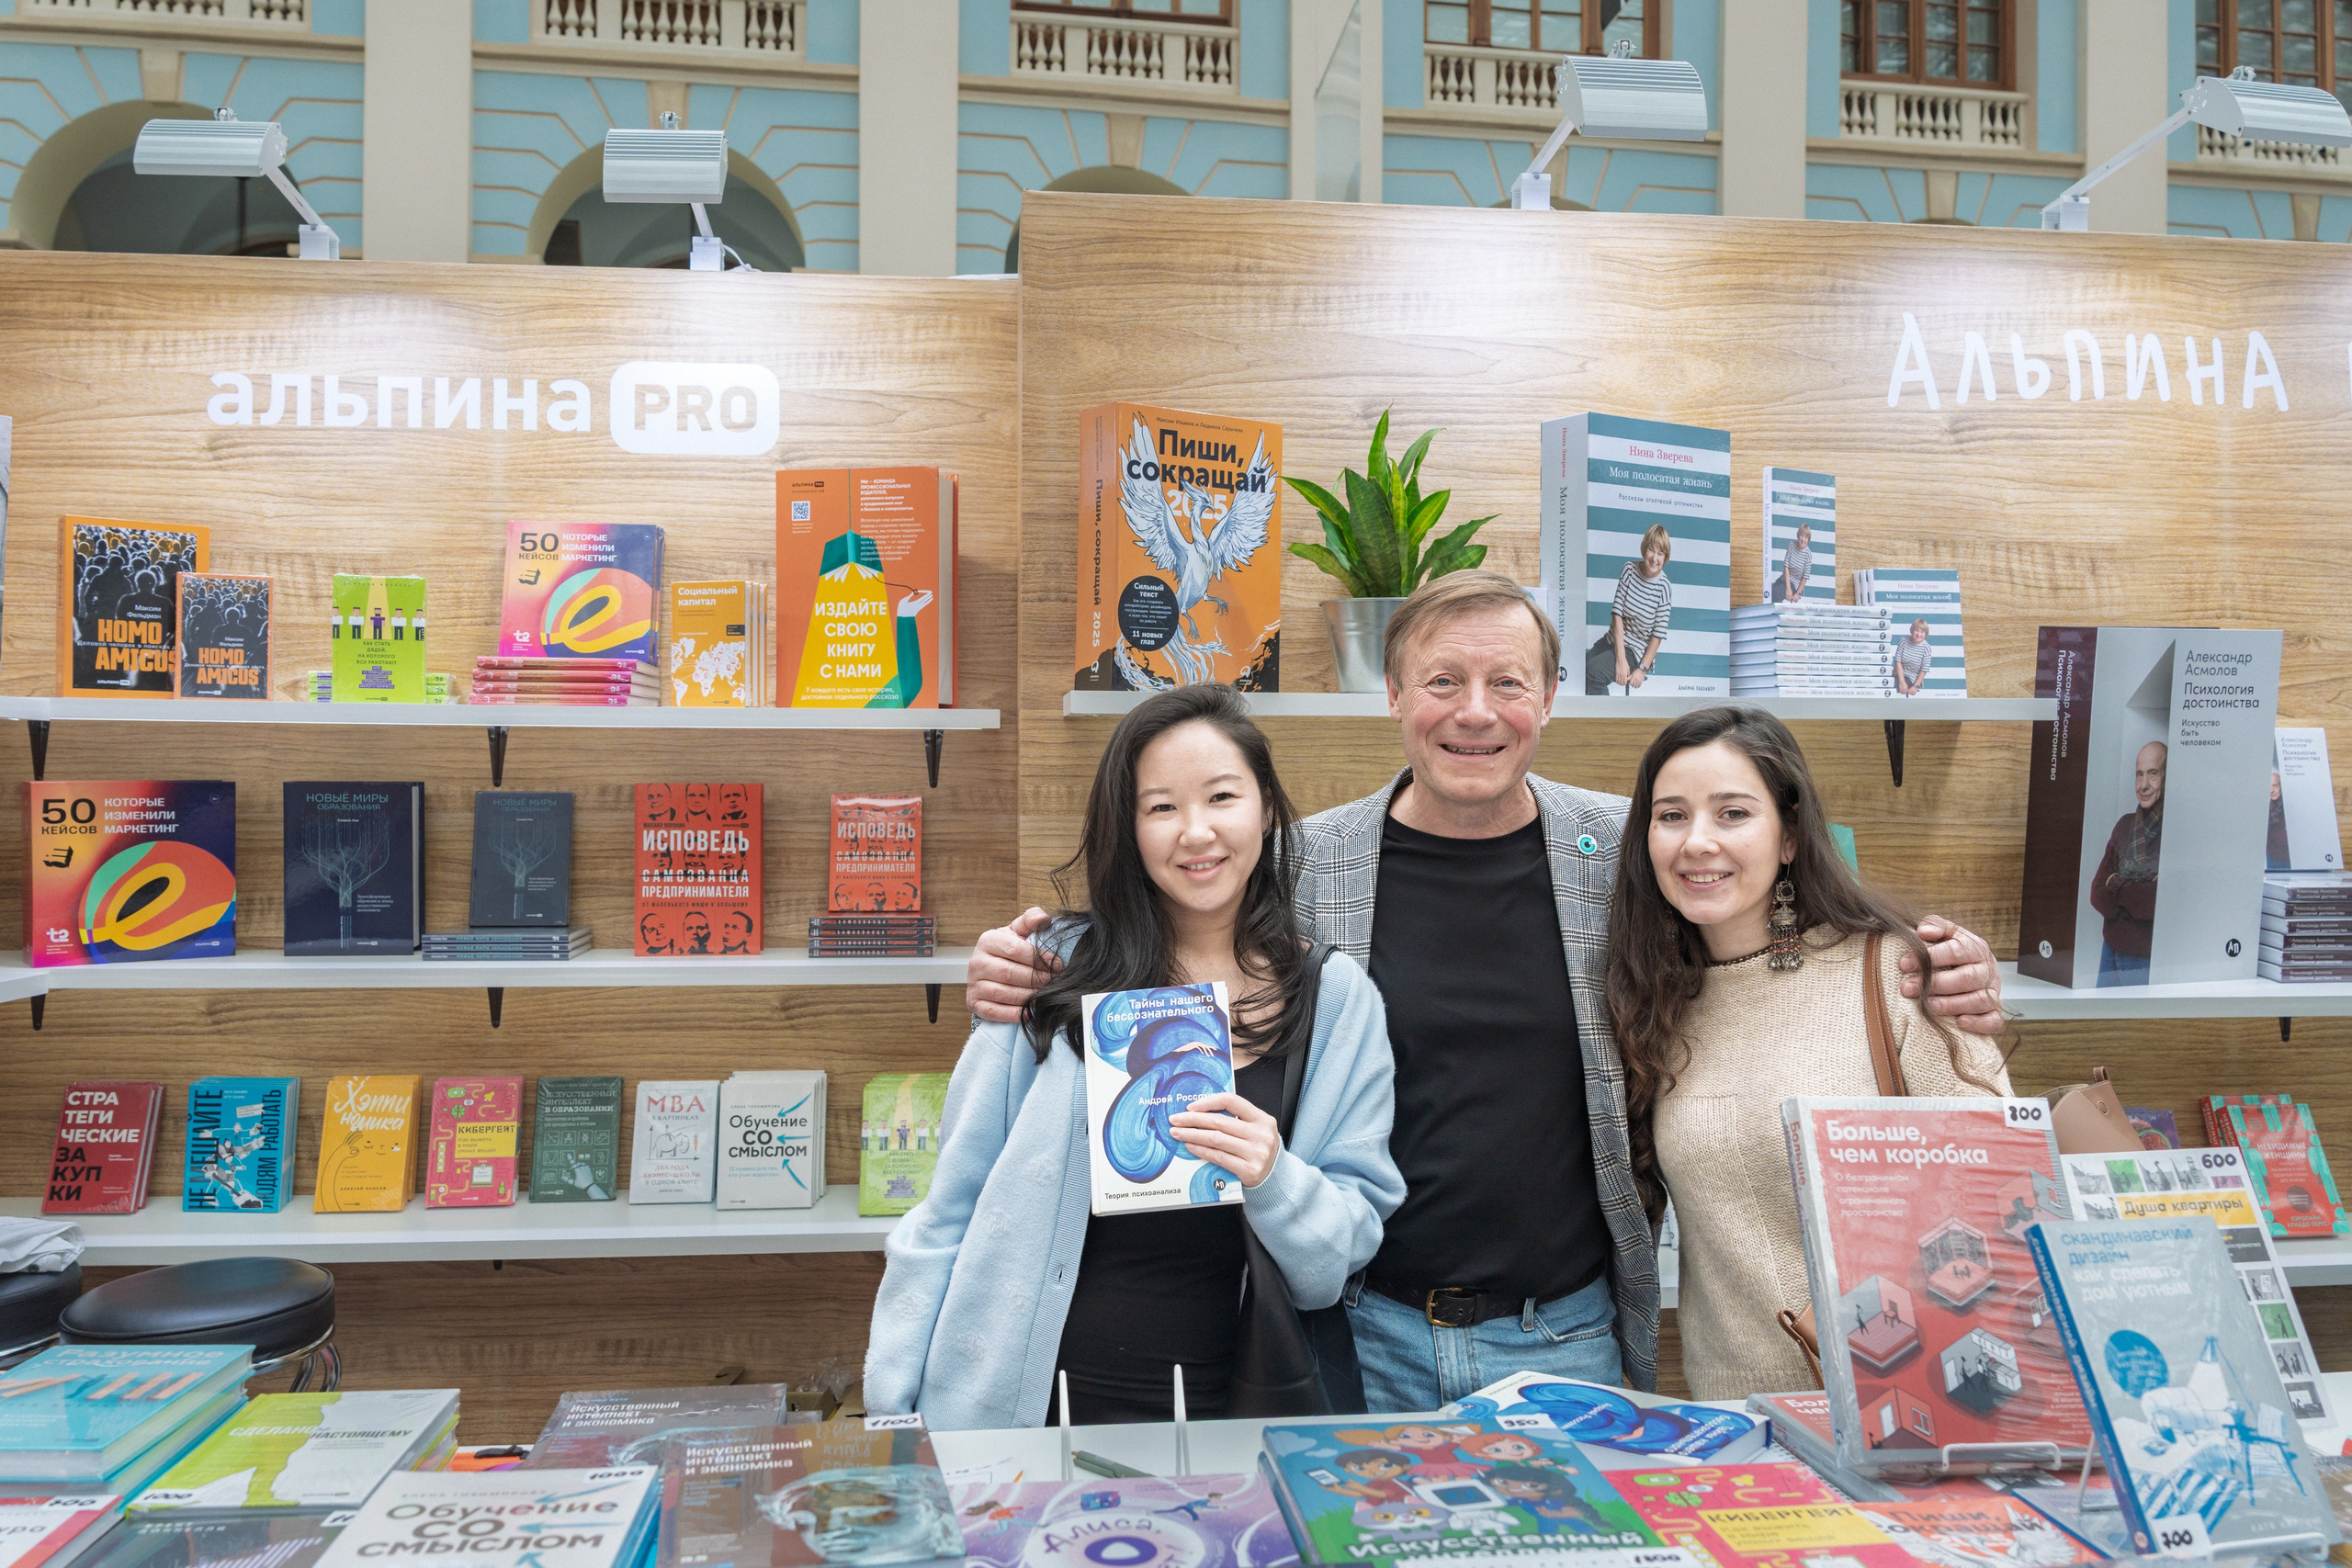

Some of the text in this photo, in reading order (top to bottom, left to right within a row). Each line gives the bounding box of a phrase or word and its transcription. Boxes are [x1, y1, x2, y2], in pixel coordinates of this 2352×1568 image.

[207, 371, 758, 433] альпина PRO
[1221, 425, 1243, 434] Сарычева
[1159, 428, 1245, 468] Пиши,
[1629, 446, 1694, 464] Нина Зверева
[1126, 459, 1267, 494] сокращай
[1610, 467, 1713, 489] Моя полосатая жизнь
[1559, 486, 1567, 514] Моя
[1619, 492, 1703, 509] Рассказы оптимистки
[520, 532, 559, 552] 50
[562, 533, 607, 542] КОТОРЫЕ
[561, 543, 615, 552] ИЗМЕНИЛИ
[518, 552, 559, 560] КЕЙСОВ
[560, 554, 617, 562] МАРКЕТИНГ
[1093, 529, 1102, 606] сокращай
[678, 586, 738, 595] Социальный
[1134, 582, 1164, 591] Сильный
[1915, 582, 1939, 591] Зверева
[135, 604, 162, 613] Максим
[678, 598, 716, 606] капитал
[815, 599, 887, 617] ИЗДАЙТЕ
[127, 612, 162, 620] Фельдман
[1821, 606, 1850, 615] полосатая
[97, 619, 163, 644] HOMO
[513, 629, 530, 642] t2
[824, 623, 877, 637] СВОЮ
[198, 648, 244, 665] HOMO
[827, 644, 876, 658] КНИГУ
[2186, 649, 2253, 667] Александр
[197, 667, 259, 685] AMICUS
[820, 664, 882, 678] С НАМИ
[2185, 663, 2238, 677] Асмолов
[811, 687, 837, 695] каждого
[2184, 682, 2254, 696] Психология
[2061, 650, 2075, 758] Александр Асмолов
[2183, 697, 2260, 710] достоинства
[2181, 718, 2221, 728] Искусство
[2180, 728, 2199, 738] быть
[2180, 739, 2222, 747] человеком
[104, 797, 165, 807] КОТОРЫЕ
[306, 793, 389, 803] НОВЫЕ МИРЫ
[493, 798, 557, 807] НОВЫЕ МИРЫ
[41, 798, 96, 824] 50
[104, 810, 175, 820] ИЗМЕНИЛИ
[41, 824, 97, 835] КЕЙСОВ
[104, 823, 179, 834] МАРКЕТИНГ
[837, 822, 916, 840] ИСПОВЕДЬ
[643, 829, 750, 853] ИСПОВЕДЬ
[836, 851, 915, 863] САМОЗВАНЦА
[836, 863, 916, 873] ПРЕДПРИНИМАТЕЛЯ
[642, 869, 749, 884] САМОЗВАНЦА
[641, 886, 749, 898] ПРЕДПРИНИМАТЕЛЯ
[46, 927, 69, 942] t2
[1129, 994, 1214, 1010] Тайны нашего
[1106, 1005, 1215, 1023] бессознательного
[68, 1091, 119, 1106] СТРА
[334, 1076, 411, 1114] Хэппи
[546, 1089, 616, 1098] ИСКУССТВЕННЫЙ
[1138, 1094, 1173, 1106] Андрей
[64, 1110, 114, 1124] ТЕГИ
[340, 1111, 404, 1132] номика
[729, 1114, 808, 1131] Обучение
[61, 1129, 140, 1143] ЧЕСКИЕ
[1826, 1120, 1927, 1145] Больше,
[187, 1089, 223, 1210] НЕ МЕШАЙТЕ
[255, 1089, 282, 1210] ЛЮДЯМ РАБОТАТЬ
[2257, 1142, 2307, 1150] НЕВИДИМЫЕ
[55, 1147, 86, 1162] ЗА
[1830, 1143, 1988, 1169] чем коробка
[2201, 1154, 2237, 1169] 600
[2264, 1152, 2306, 1160] ЖЕНЩИНЫ
[52, 1166, 102, 1181] КУП
[1846, 1173, 1909, 1183] безграничном
[49, 1185, 82, 1201] КИ
[1104, 1188, 1182, 1200] Теория психоанализа
[1838, 1185, 1889, 1193] потенциале
[1839, 1197, 1906, 1206] ограниченного
[2125, 1199, 2244, 1217] Душа квартиры
[1841, 1209, 1903, 1217] пространства
[2061, 1224, 2194, 1248] скандинавский
[2073, 1266, 2182, 1282] как сделать
[2031, 1237, 2077, 1349] скандинавский
[2082, 1281, 2192, 1303] дом уютным
[57, 1348, 224, 1359] Разумное
[43, 1359, 211, 1367] страхование
[571, 1402, 680, 1413] Искусственный
[566, 1411, 641, 1420] интеллект
[574, 1417, 654, 1427] экономика
[870, 1417, 918, 1427] 1100
[310, 1429, 413, 1439] НАСТОЯЩЕМУ
[686, 1439, 813, 1457] Искусственный
[685, 1452, 773, 1467] интеллект
[700, 1459, 793, 1474] экономика
[386, 1502, 618, 1520] Обучение
[1890, 1511, 2001, 1522] Пиши,
[1044, 1517, 1161, 1554] Алиса,
[2162, 1529, 2193, 1549] 700
[1349, 1531, 1645, 1558] Искусственный
